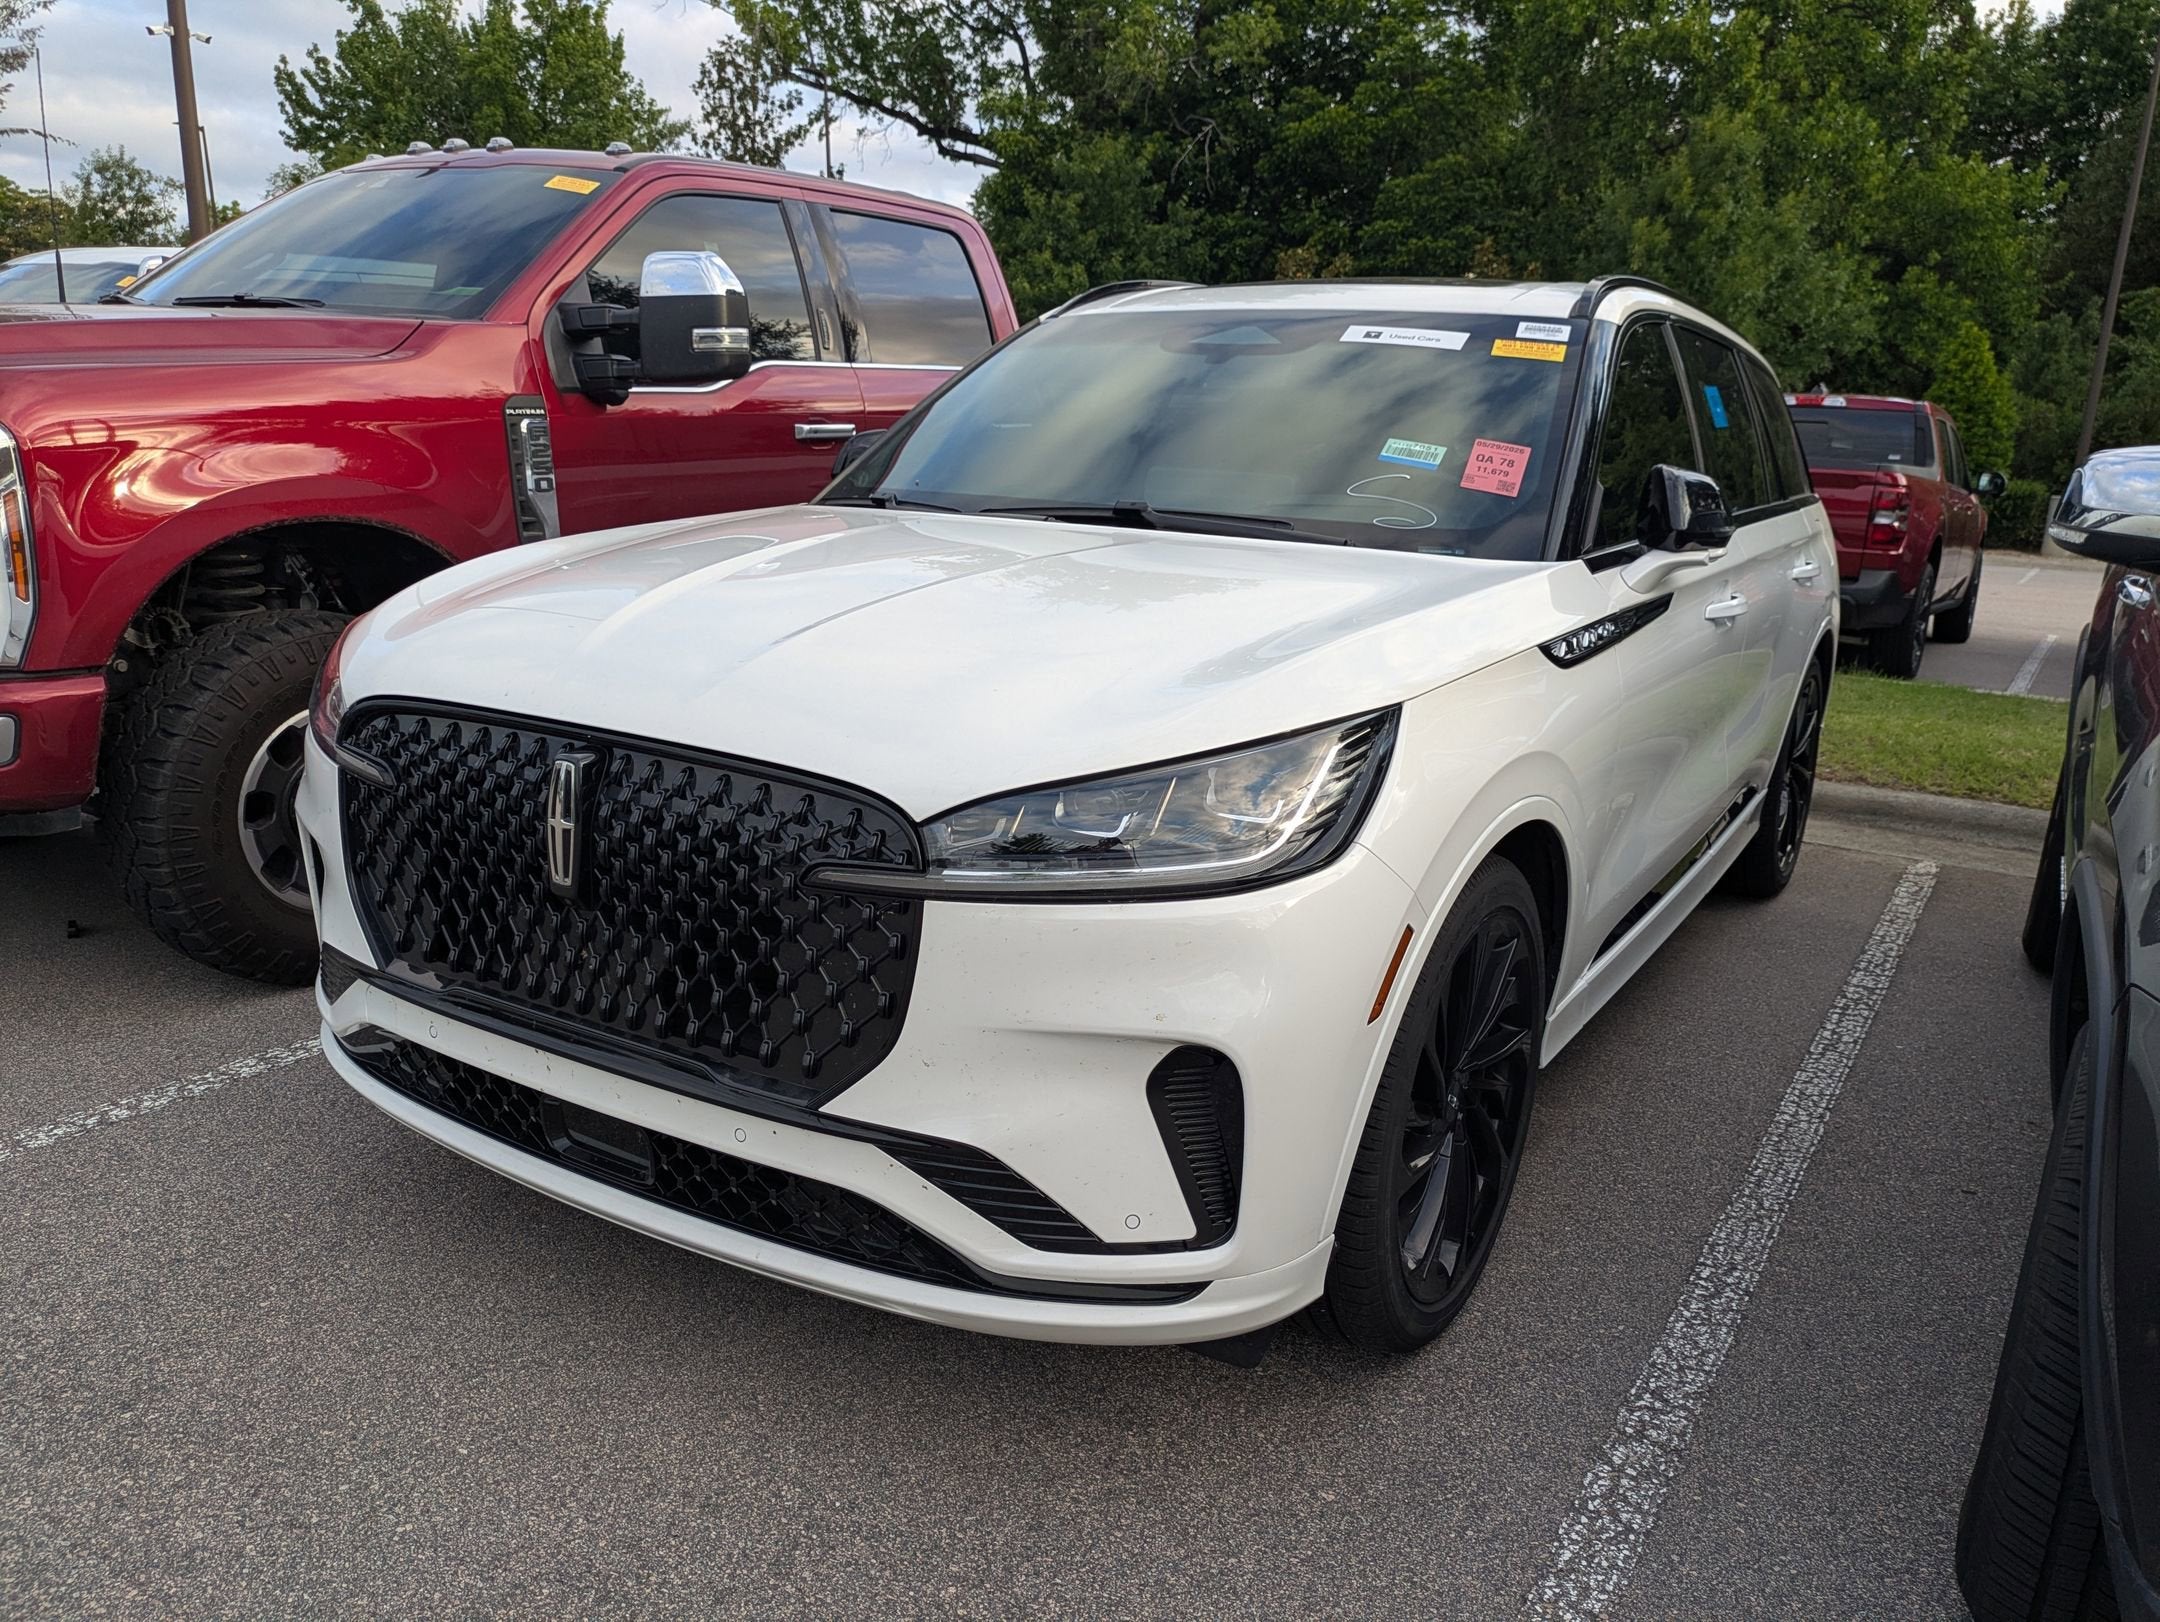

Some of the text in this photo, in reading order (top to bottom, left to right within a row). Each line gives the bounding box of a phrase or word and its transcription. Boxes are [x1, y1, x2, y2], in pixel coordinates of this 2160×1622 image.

[1389, 333, 1416, 341] Used
[1476, 440, 1525, 454] 05/29/2026
[1476, 453, 1494, 464] QA
[1500, 457, 1515, 468] 78
[1477, 466, 1510, 478] 11,679
